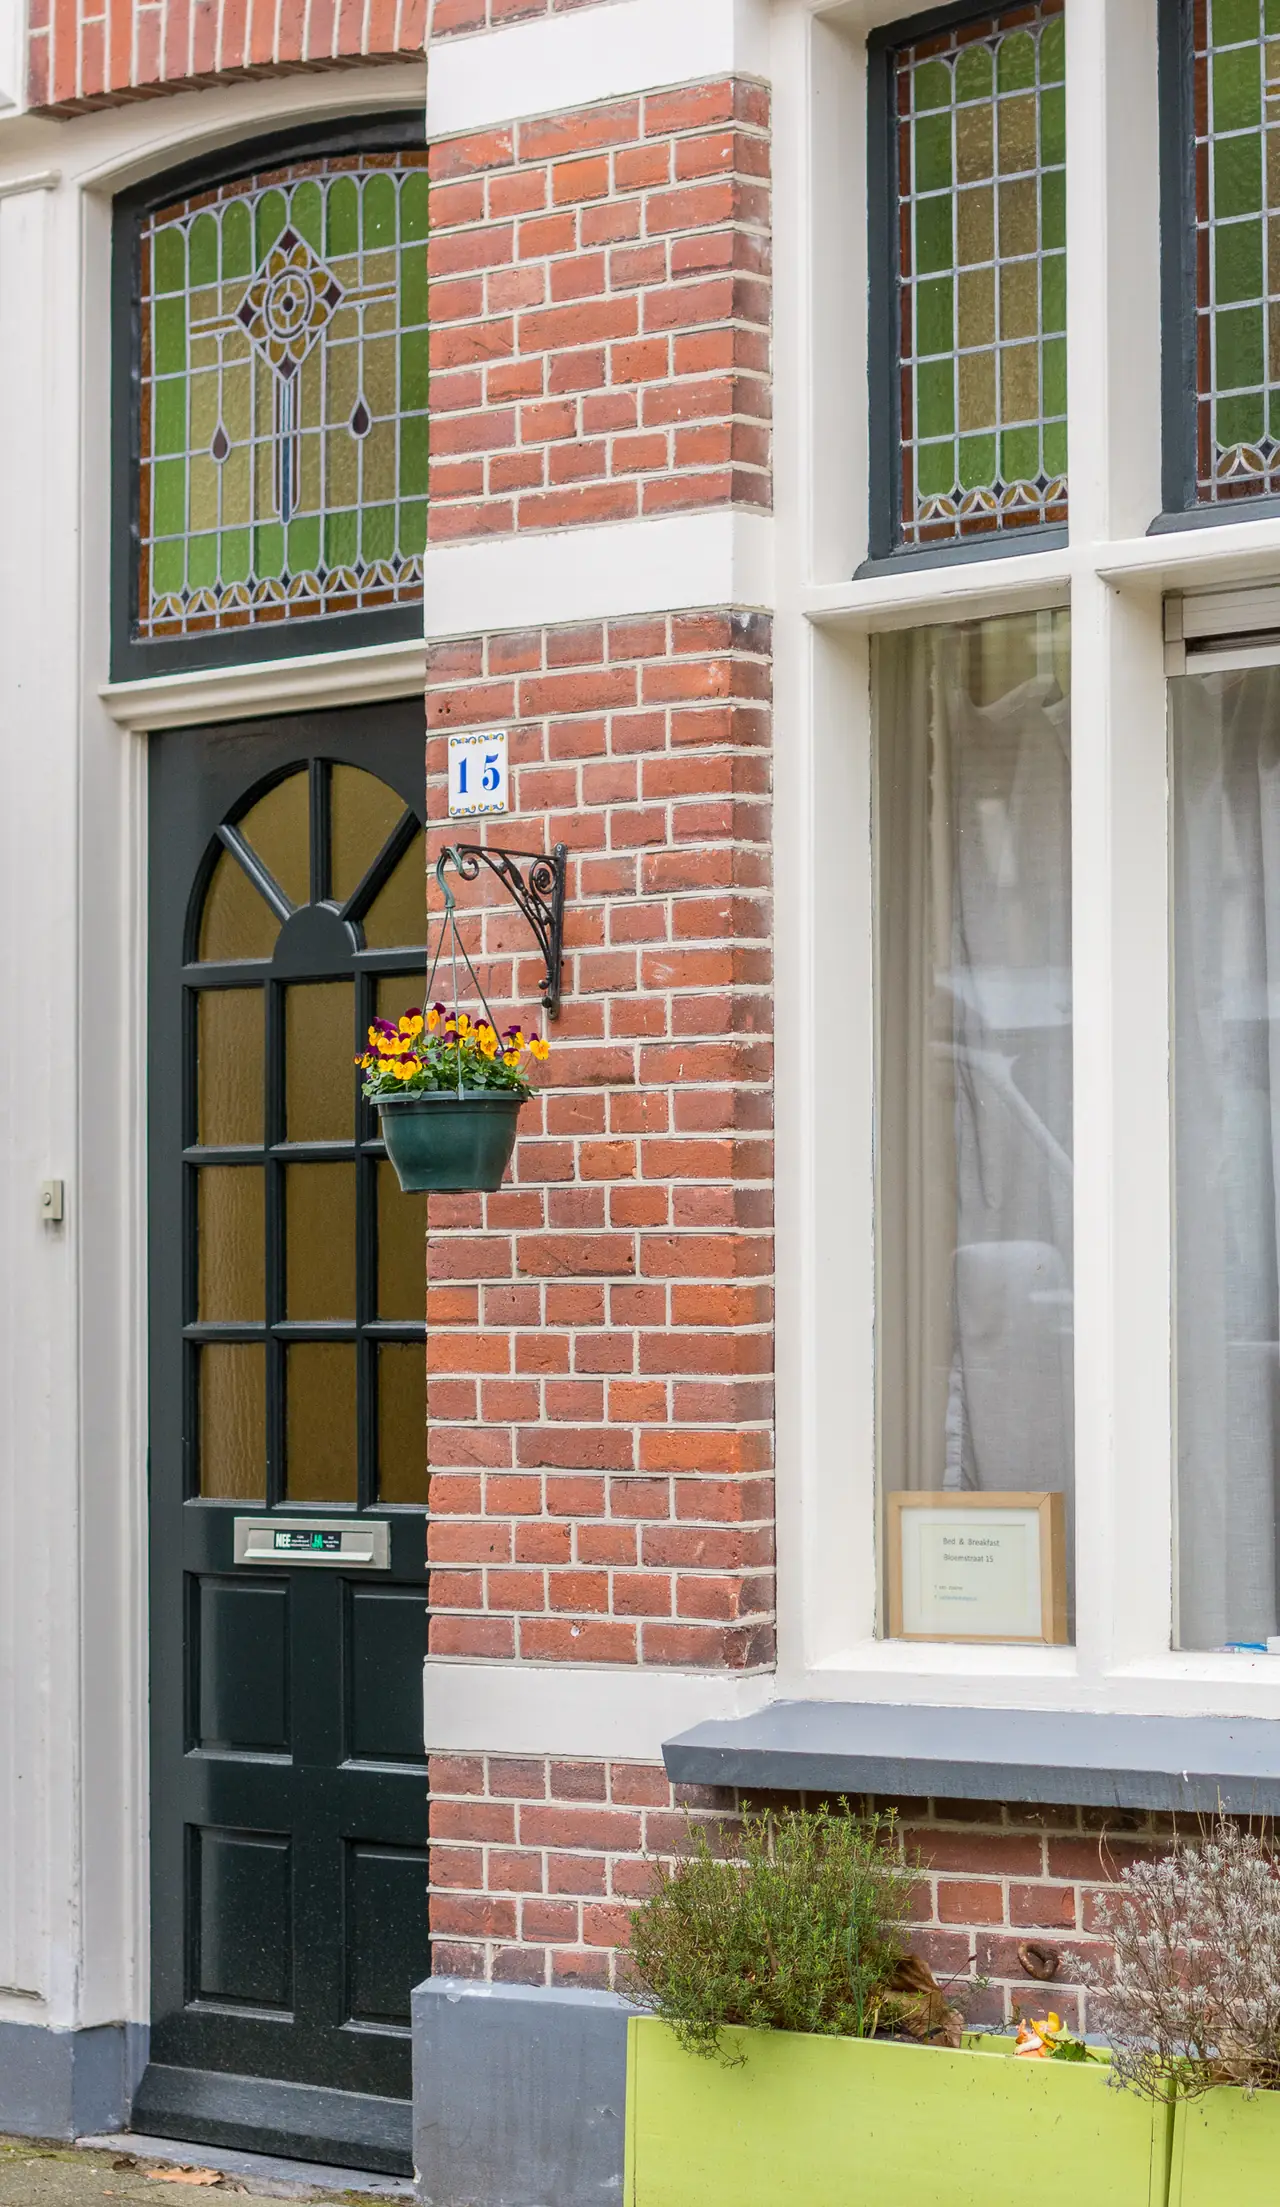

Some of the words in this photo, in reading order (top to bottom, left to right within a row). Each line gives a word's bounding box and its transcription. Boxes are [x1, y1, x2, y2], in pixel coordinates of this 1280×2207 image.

[457, 753, 500, 794] 15
[276, 1533, 291, 1547] NEE
[312, 1534, 323, 1548] JA
[942, 1537, 955, 1545] Bed
[959, 1538, 965, 1546] &
[967, 1538, 1000, 1547] Breakfast
[943, 1553, 984, 1563] Bloemstraat
[985, 1555, 994, 1563] 15
